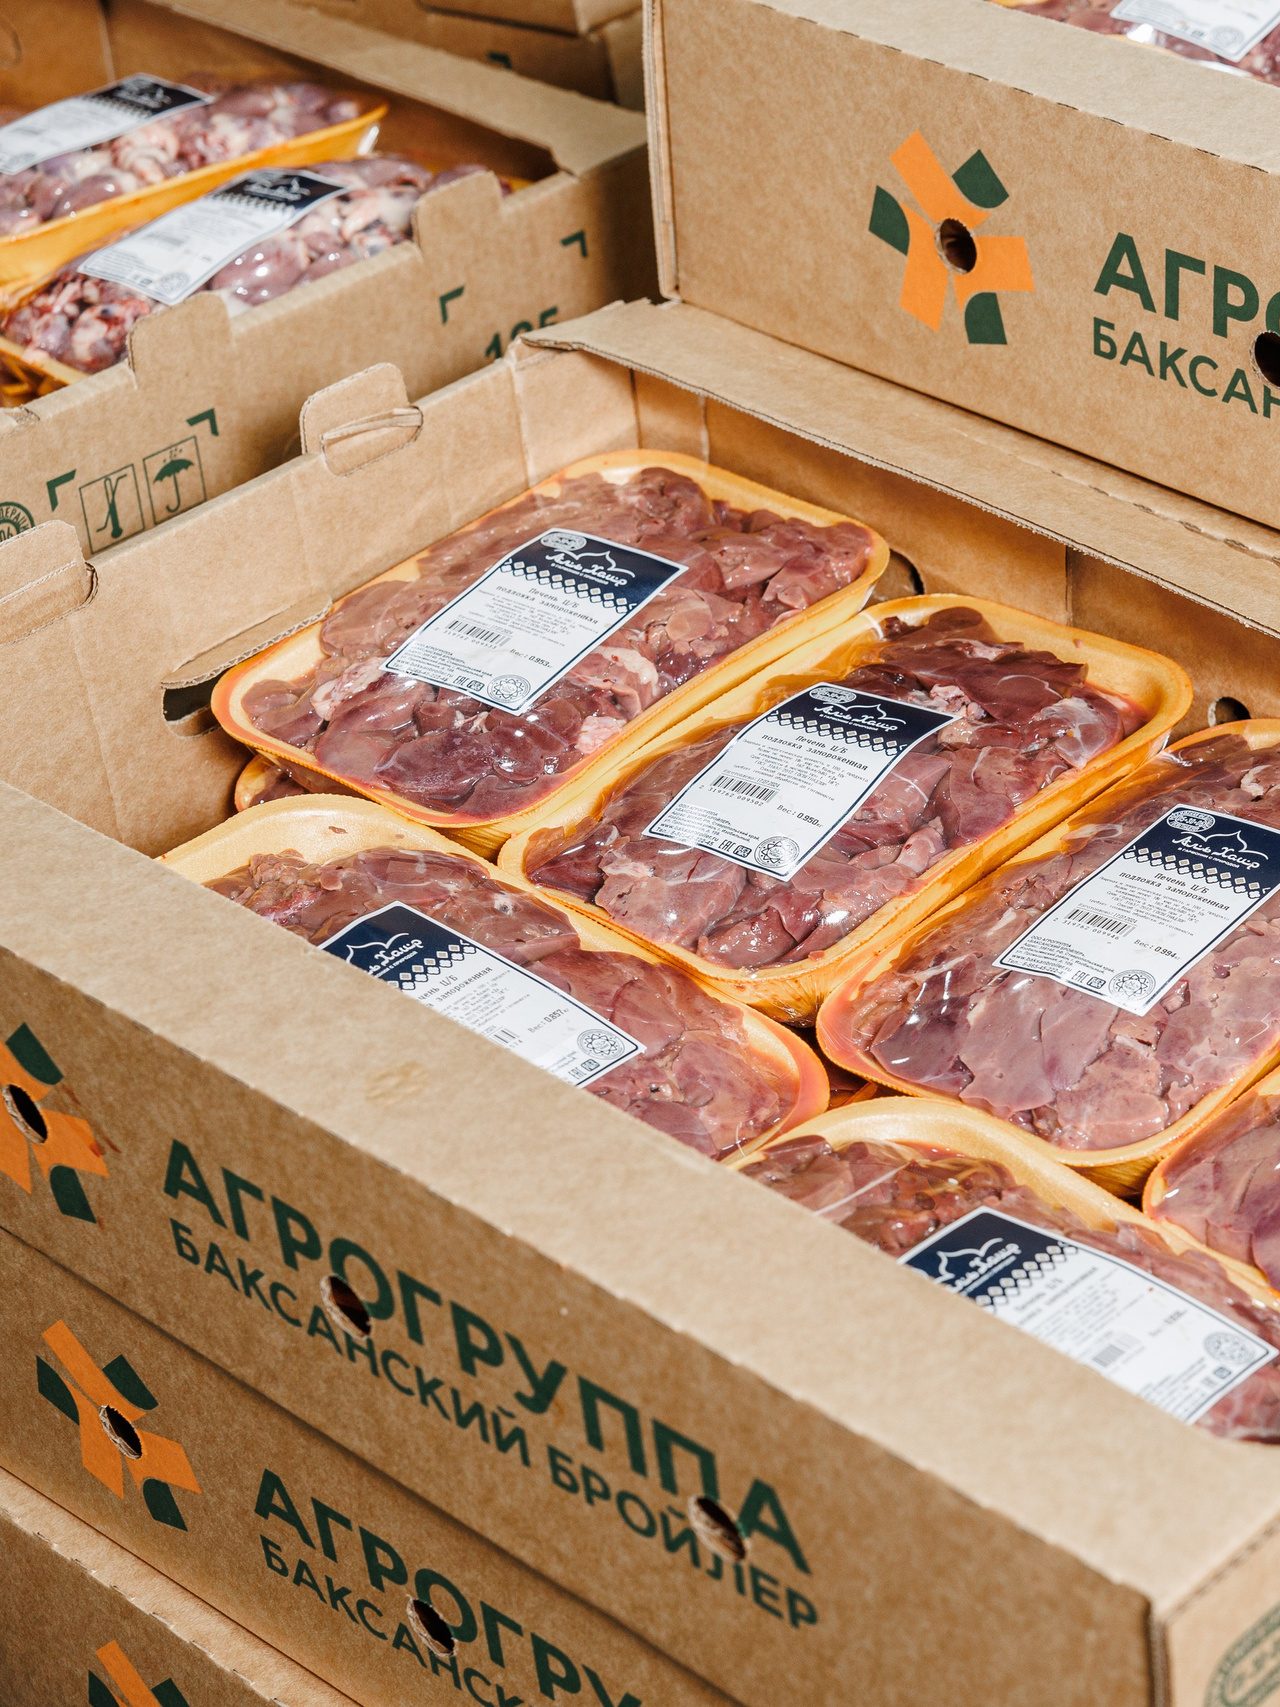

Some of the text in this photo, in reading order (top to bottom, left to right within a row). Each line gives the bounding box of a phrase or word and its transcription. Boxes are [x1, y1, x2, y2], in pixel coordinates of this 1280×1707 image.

[545, 553, 583, 571] Аль
[529, 588, 579, 608] Печень Ц/Б
[541, 601, 598, 624] замороженная
[814, 705, 897, 732] Аль Хаир
[762, 735, 868, 771] подложка замороженная
[795, 736, 848, 753] Печень Ц/Б
[777, 805, 796, 815] Вес:
[1172, 836, 1260, 870] Аль Хаир
[1119, 872, 1230, 911] подложка замороженная
[1154, 873, 1209, 893] Печень Ц/Б
[1134, 939, 1154, 949] Вес:
[436, 966, 493, 1003] замороженная
[439, 974, 459, 988] Ц/Б
[170, 1218, 531, 1469] БАКСАНСКИЙ
[163, 1138, 813, 1576] АГРОГРУППА
